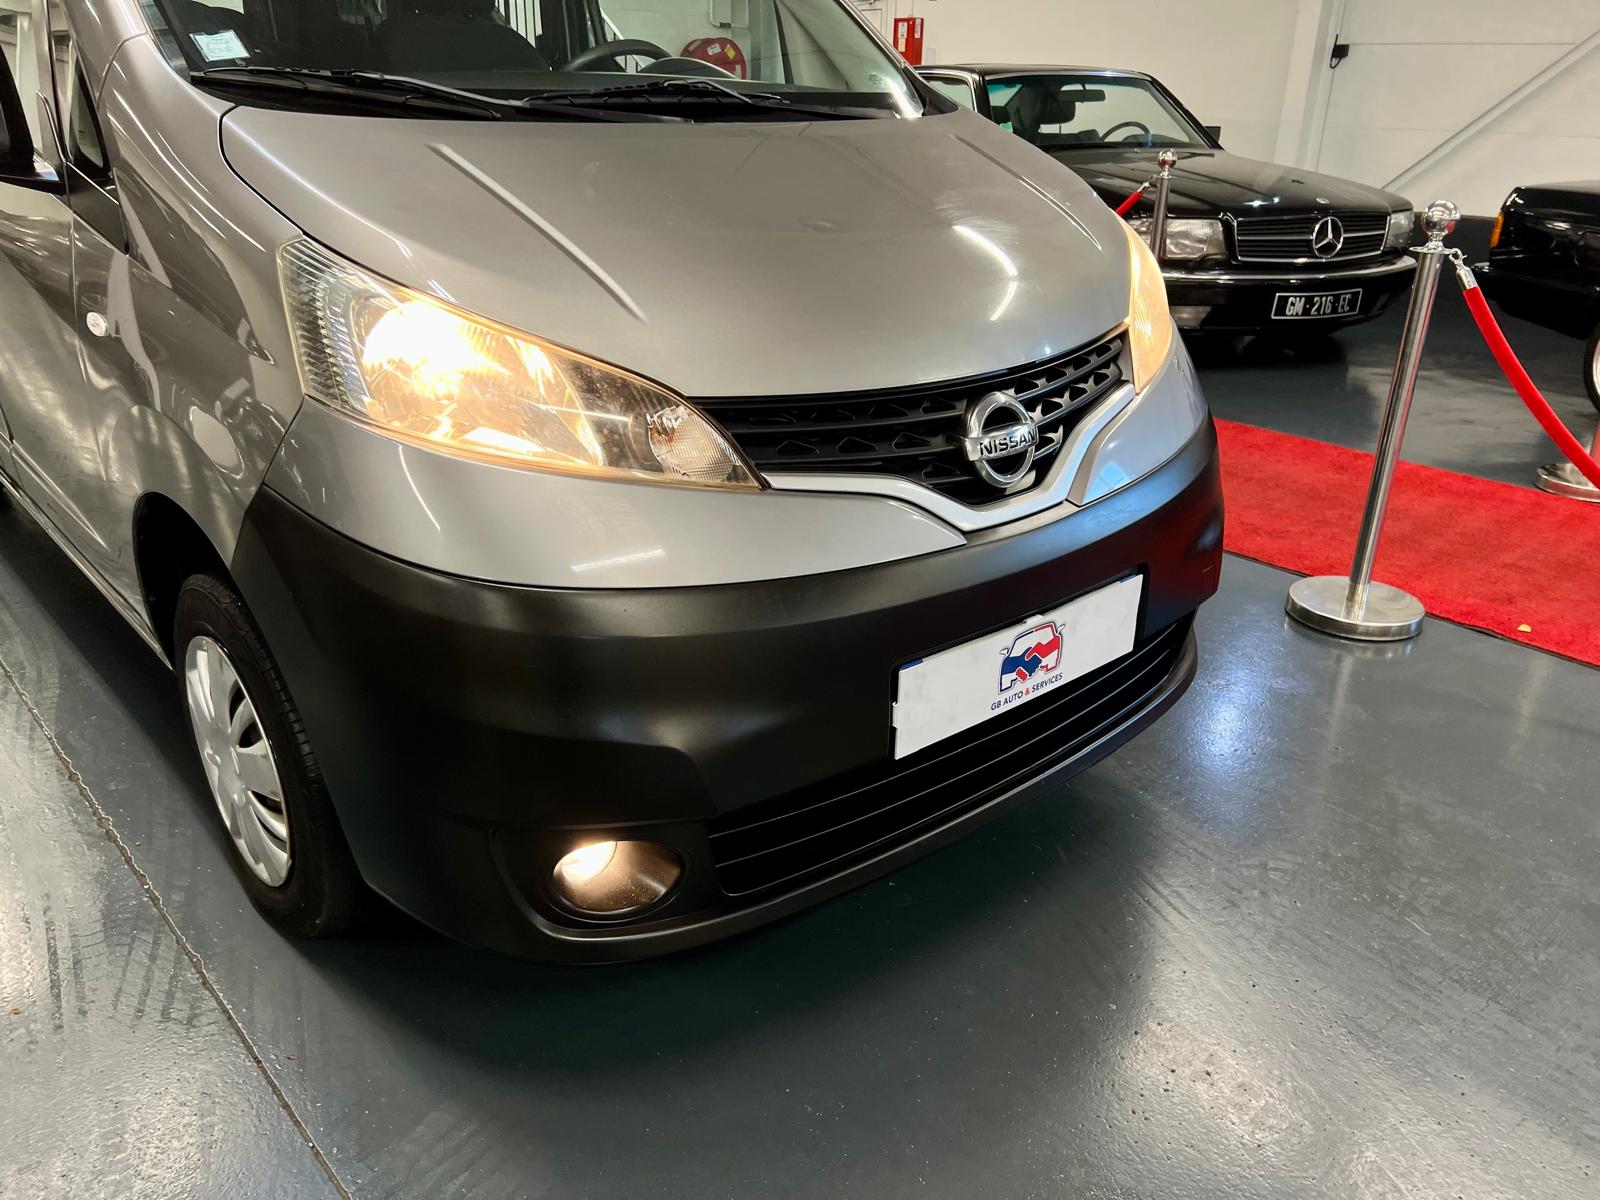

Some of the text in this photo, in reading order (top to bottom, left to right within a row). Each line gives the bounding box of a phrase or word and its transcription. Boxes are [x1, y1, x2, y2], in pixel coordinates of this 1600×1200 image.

[1310, 295, 1334, 316] 216
[979, 430, 1037, 456] NISSAN
[990, 672, 1063, 711] GB AUTO & SERVICES
